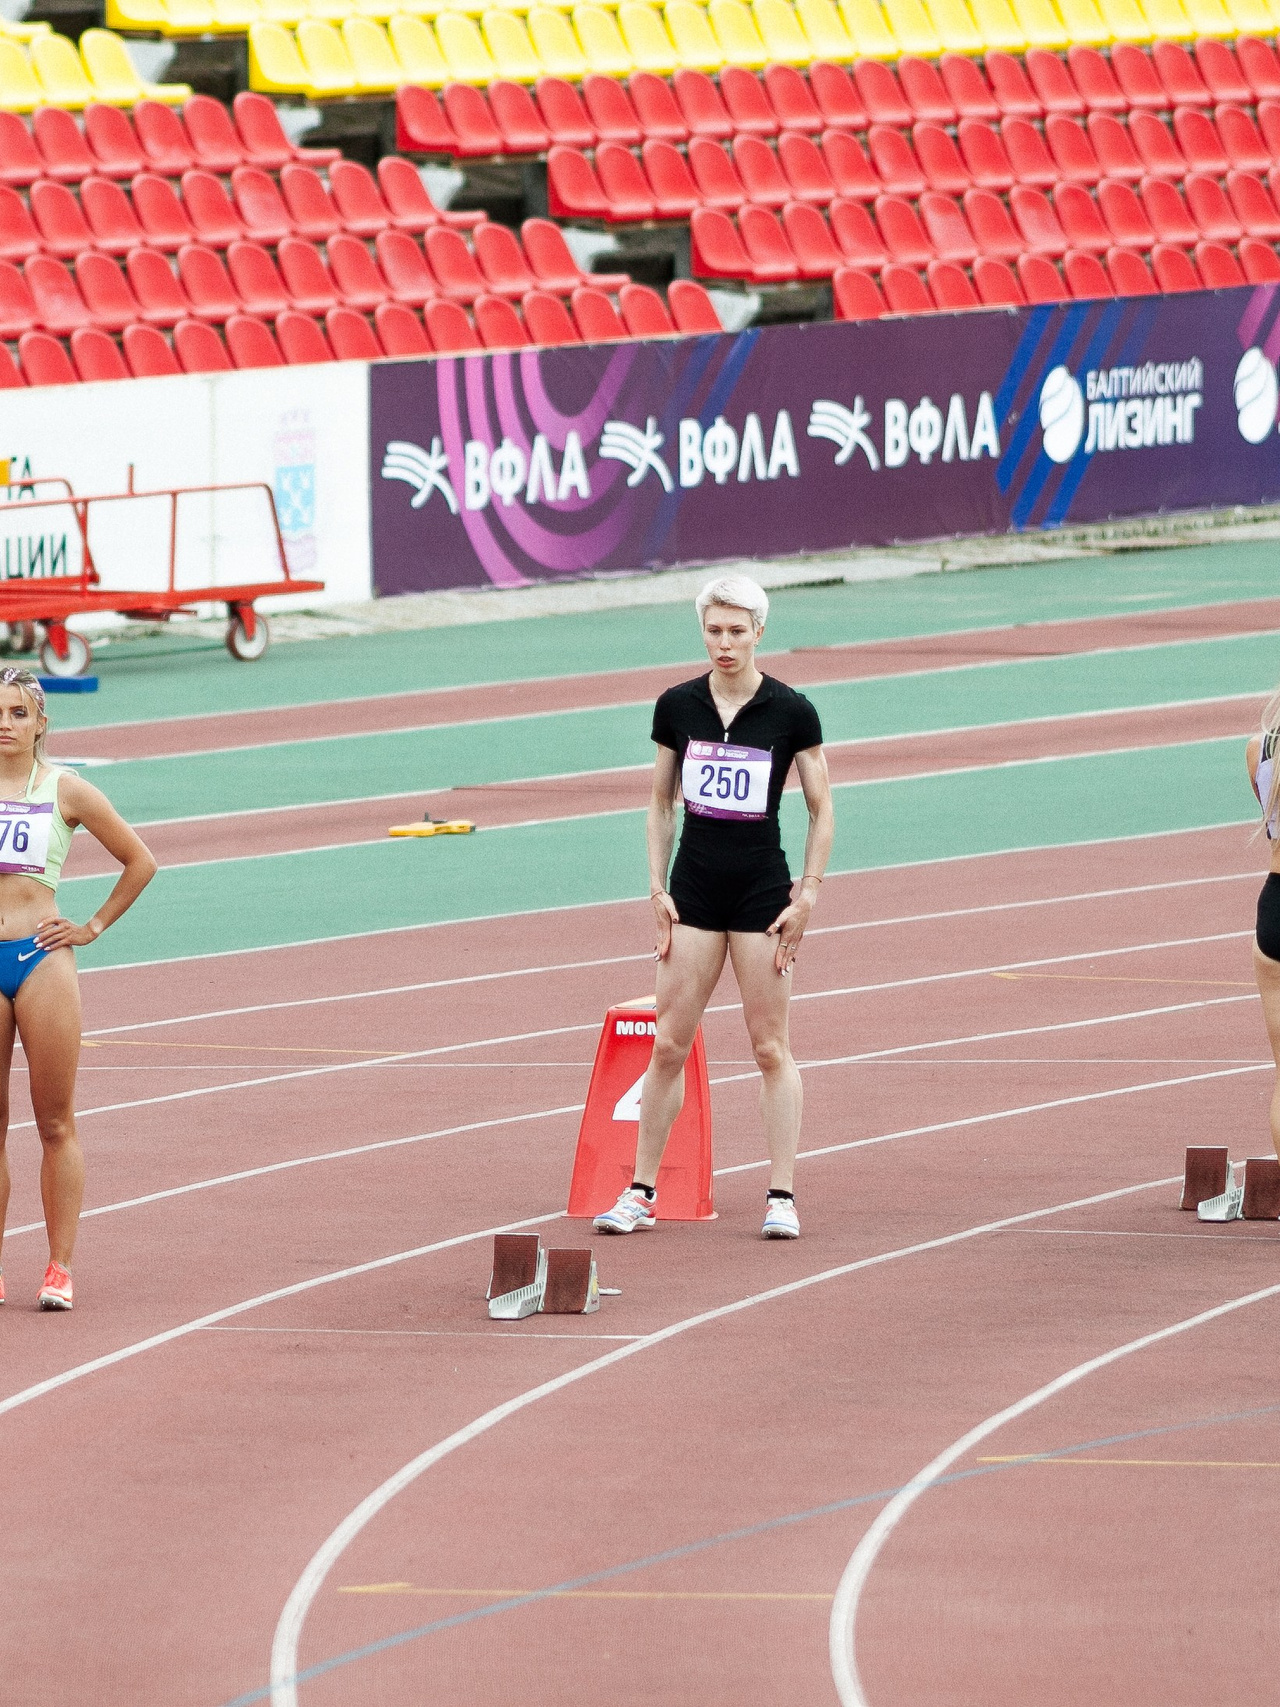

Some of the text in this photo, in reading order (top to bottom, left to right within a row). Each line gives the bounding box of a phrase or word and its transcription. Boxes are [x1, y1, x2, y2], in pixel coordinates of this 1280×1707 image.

[1086, 356, 1204, 400] БАЛТИЙСКИЙ
[678, 408, 800, 487] ВФЛА
[884, 391, 1000, 468] ВФЛА
[1084, 392, 1203, 454] ЛИЗИНГ
[464, 431, 592, 511] ВФЛА
[699, 764, 750, 800] 250
[615, 1020, 658, 1036] MON
